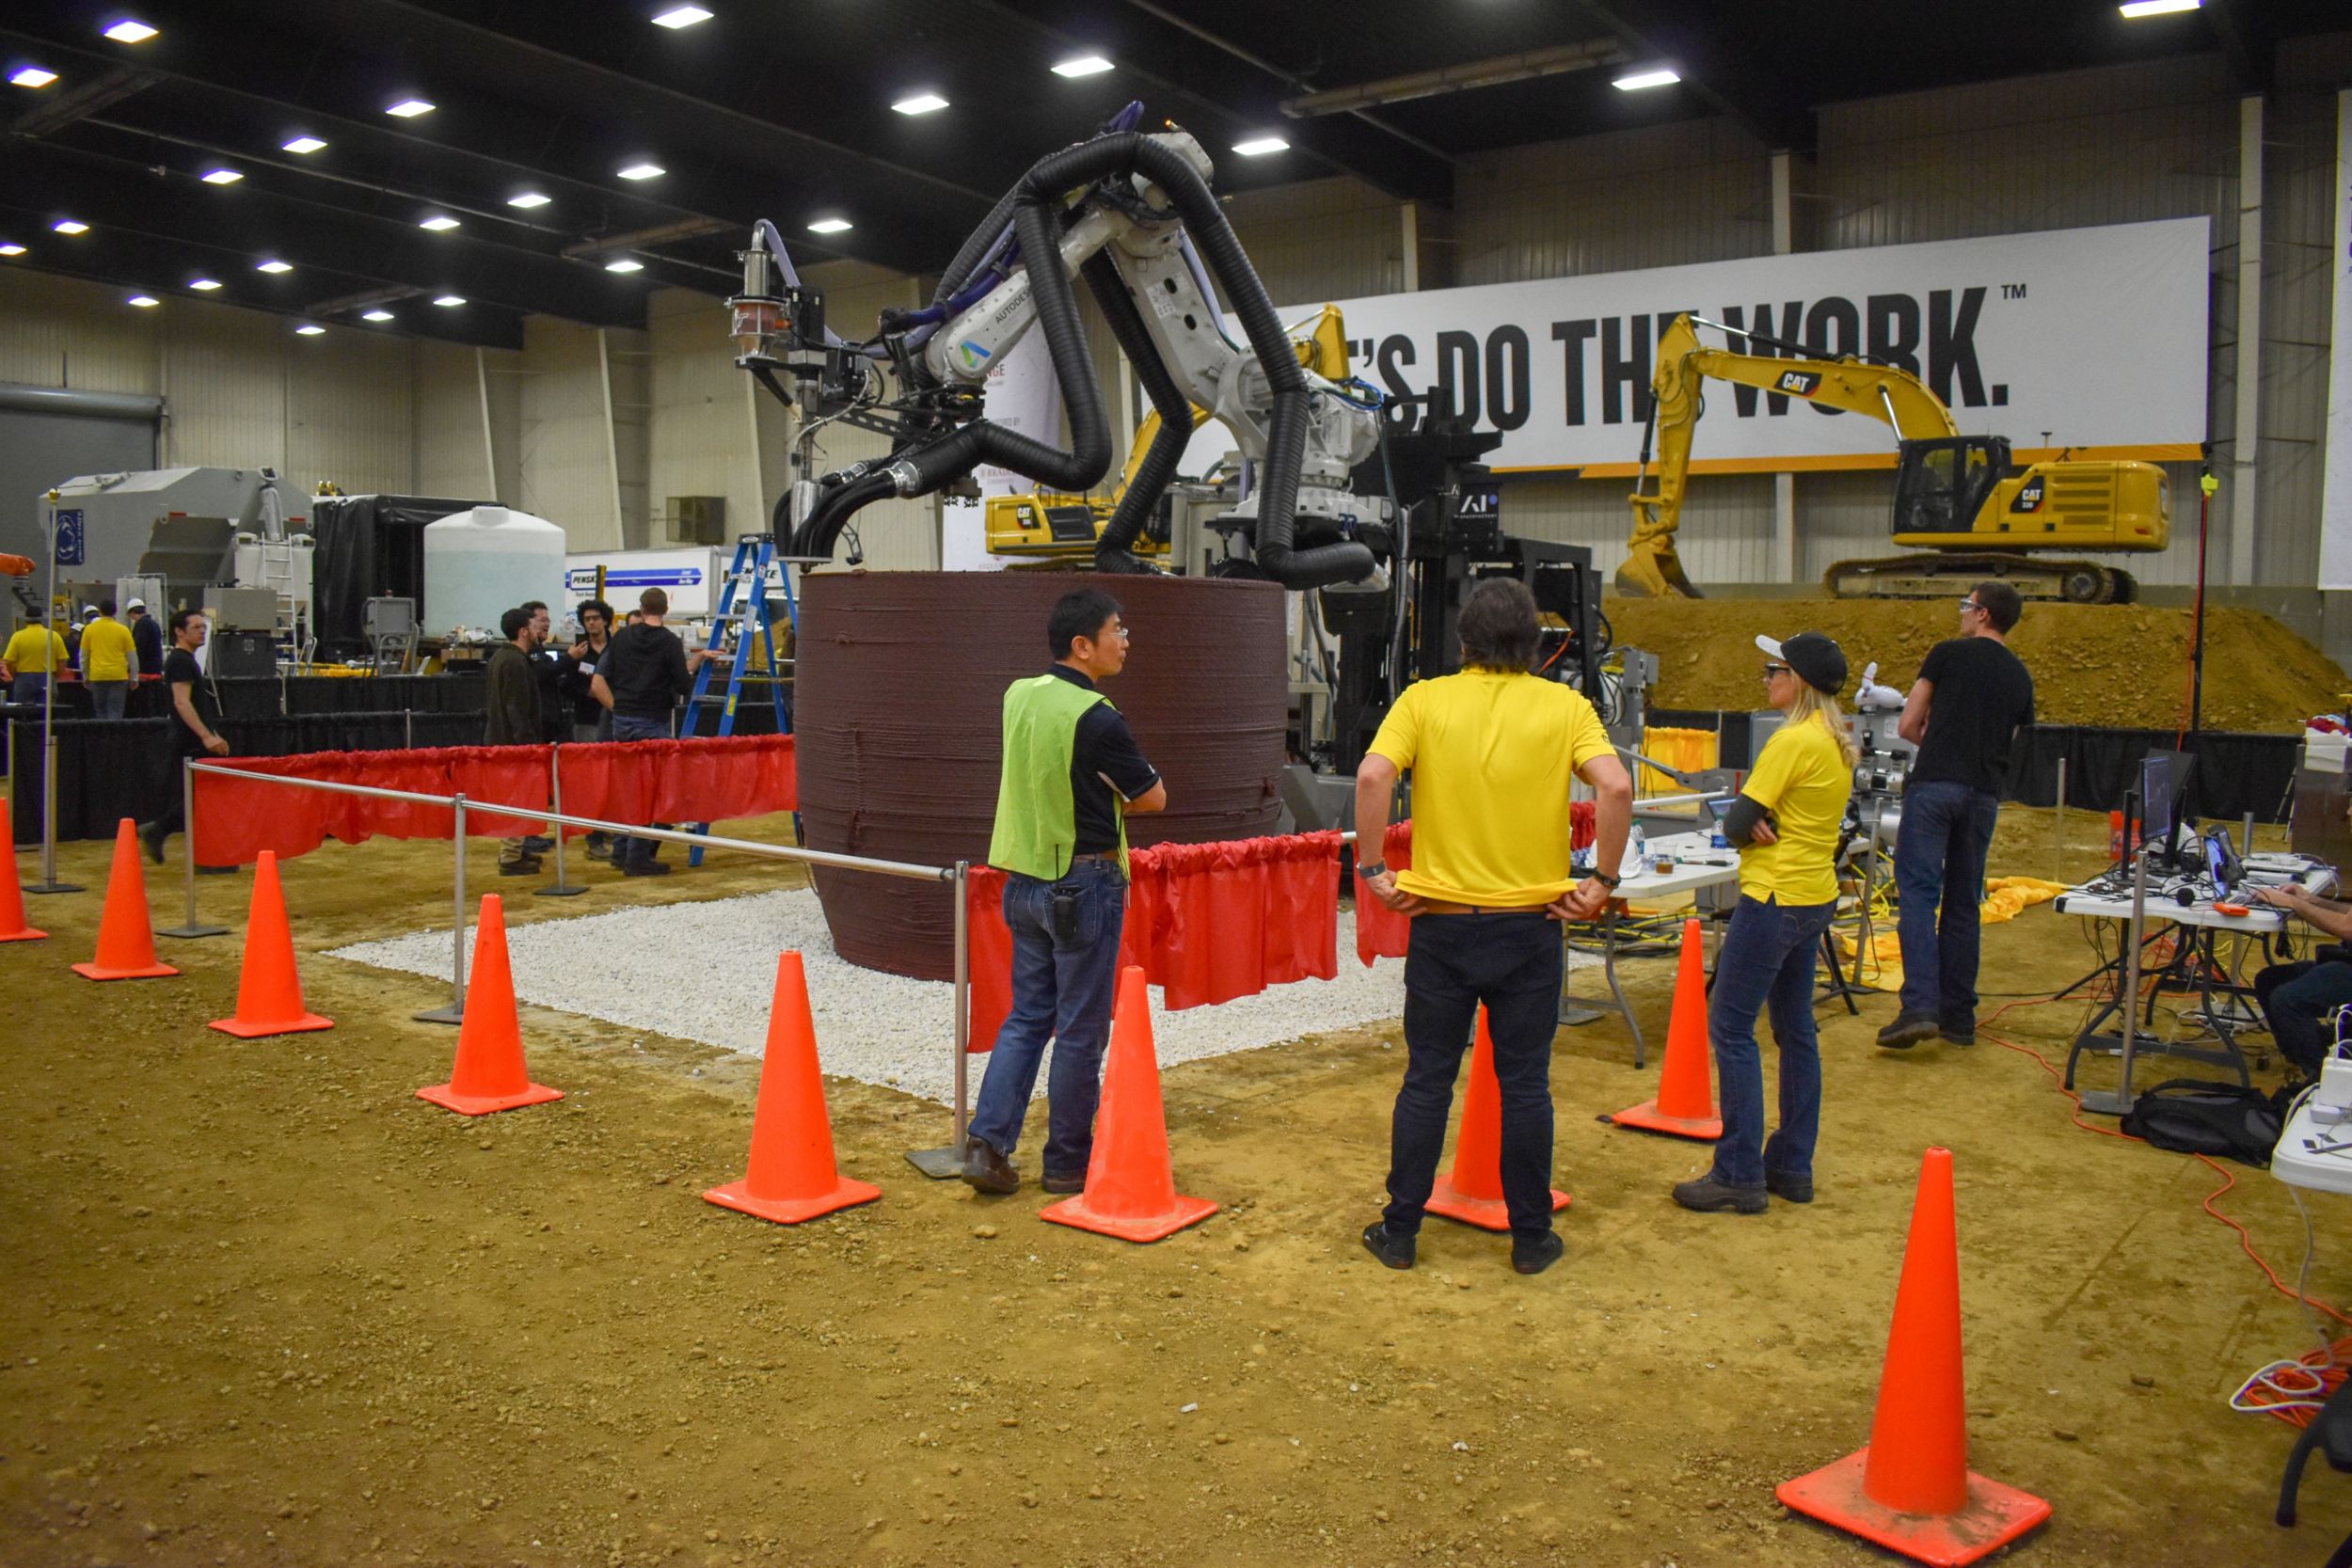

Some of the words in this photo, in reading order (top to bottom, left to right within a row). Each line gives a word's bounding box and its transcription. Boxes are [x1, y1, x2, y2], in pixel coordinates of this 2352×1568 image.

[2001, 283, 2026, 299] TM
[995, 289, 1031, 325] AUTODES
[1437, 324, 1529, 432] DO
[1782, 372, 1810, 392] CAT
[2022, 488, 2042, 500] CAT
[1017, 506, 1031, 518] CAT
